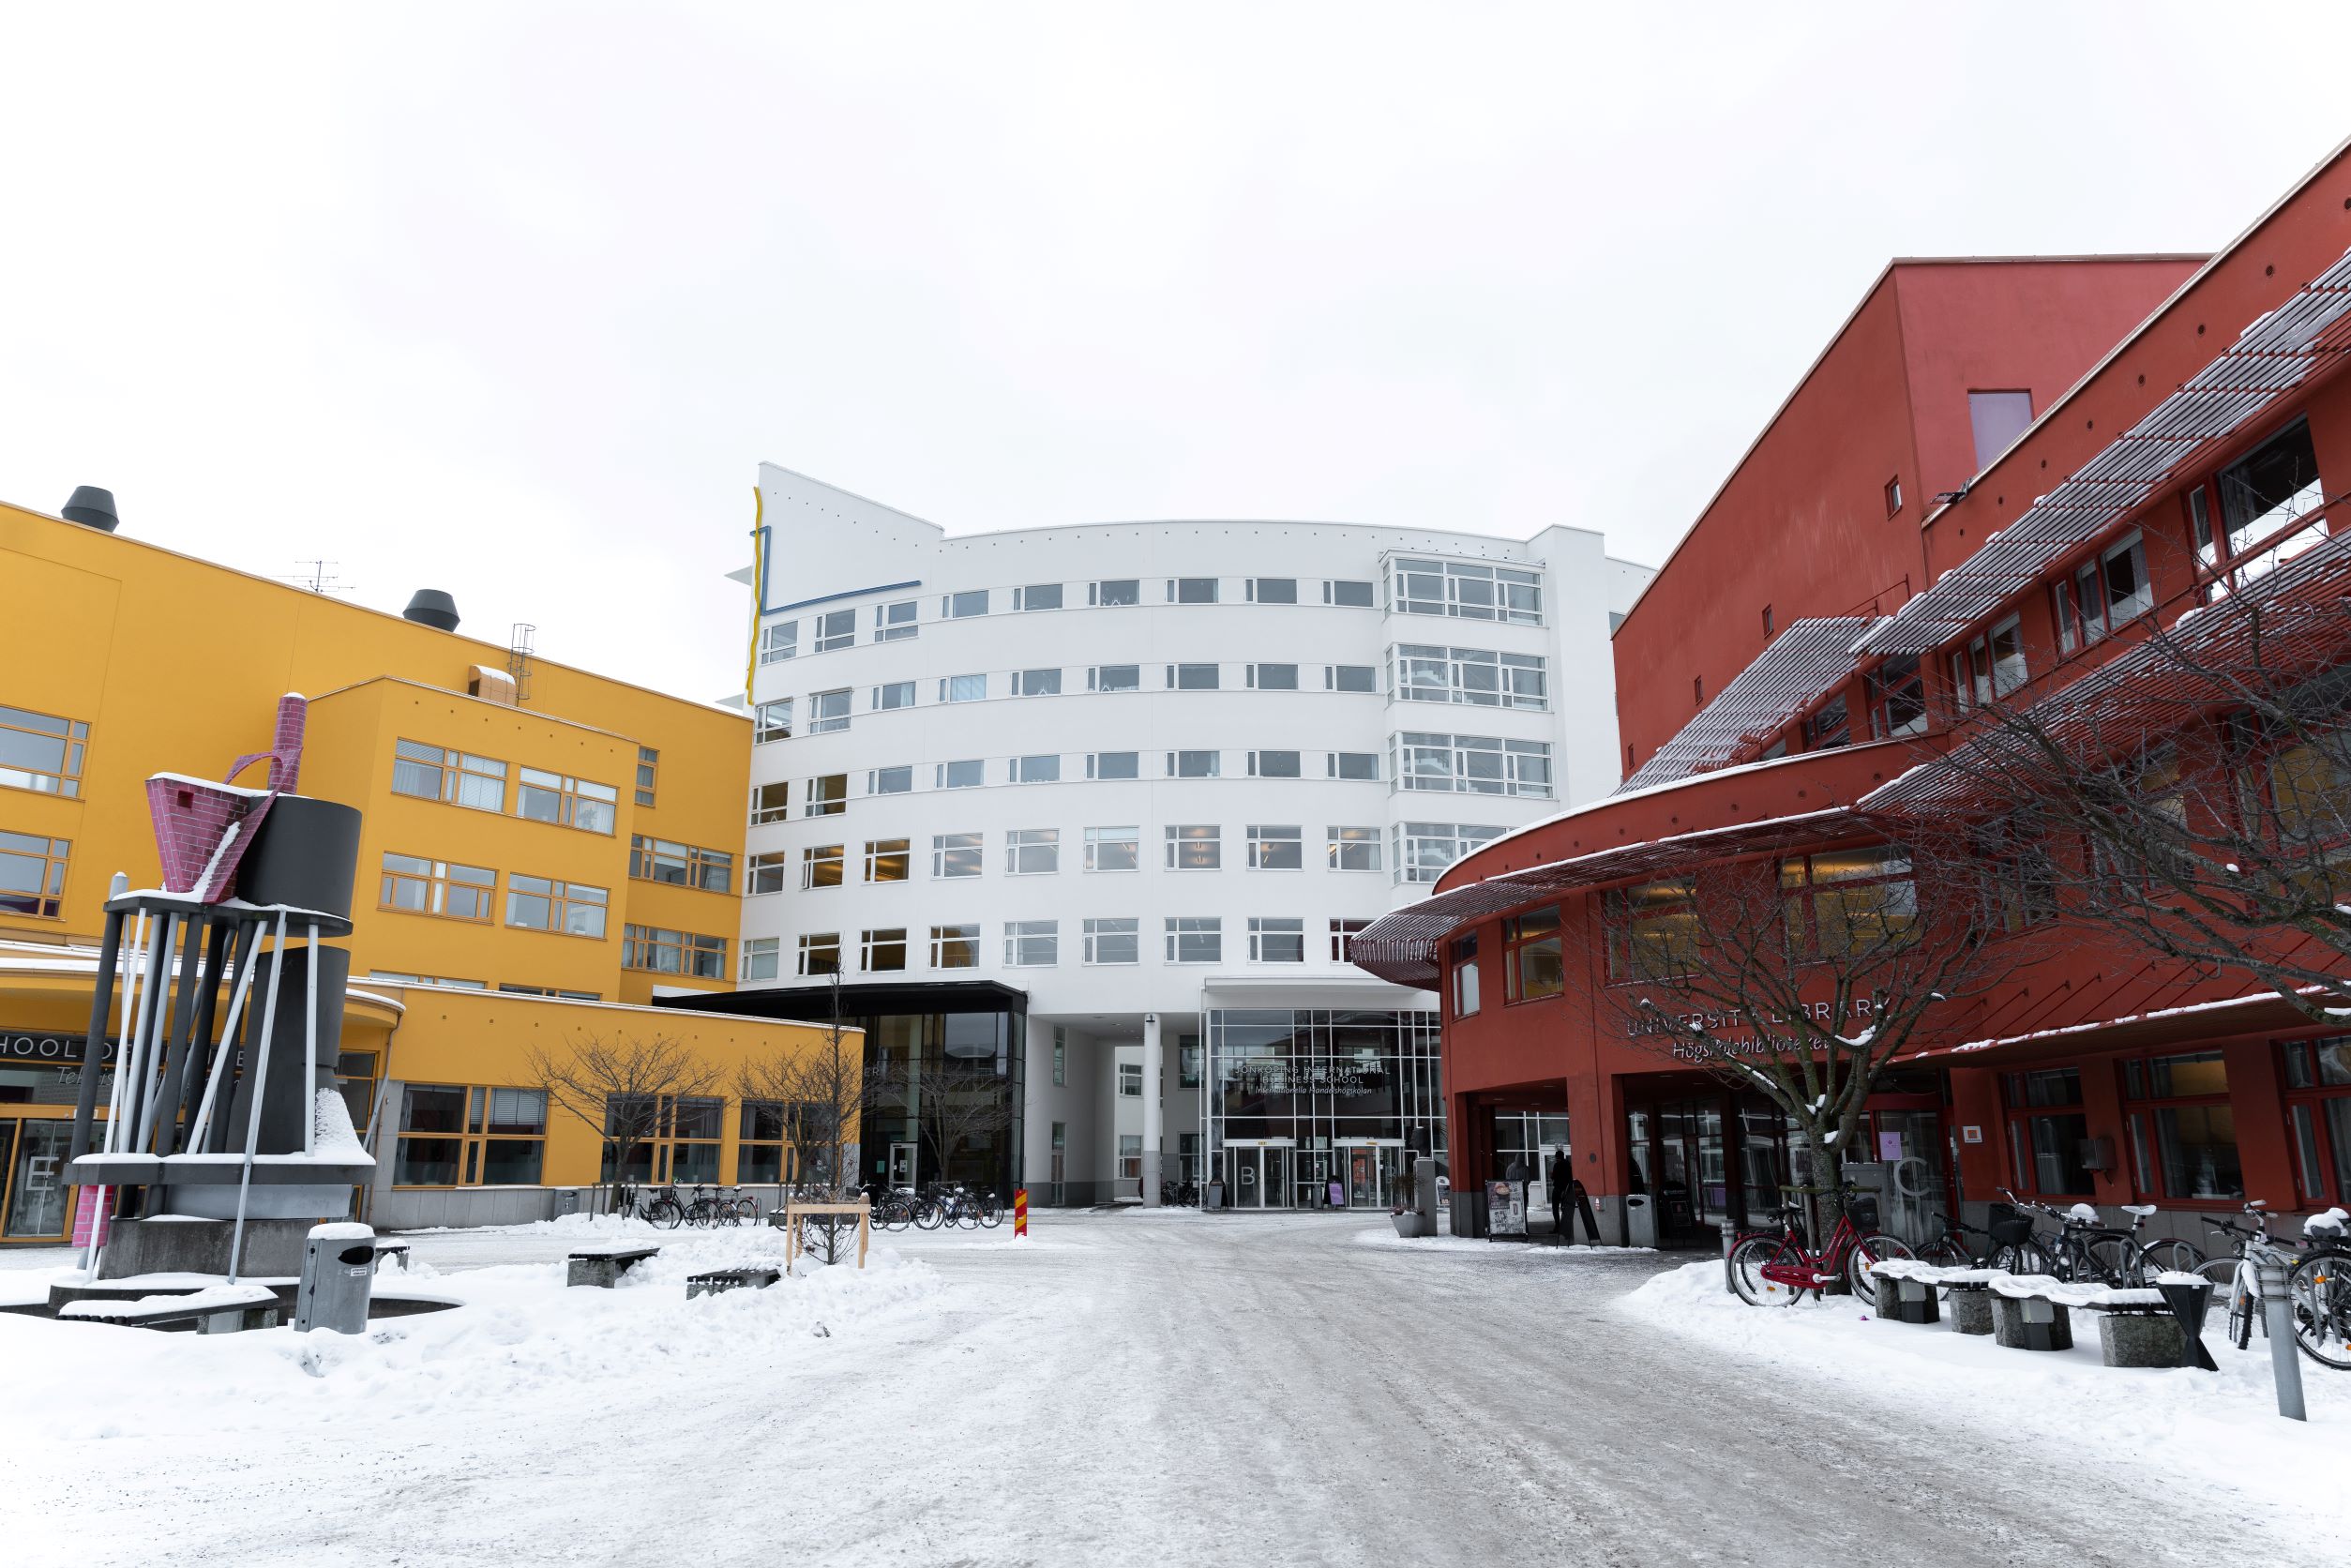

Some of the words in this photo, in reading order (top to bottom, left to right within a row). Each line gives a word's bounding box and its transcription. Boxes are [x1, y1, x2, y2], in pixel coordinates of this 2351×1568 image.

[1627, 1008, 1757, 1035] UNIVERSIT
[1771, 998, 1890, 1023] LBRR
[1234, 1064, 1299, 1075] JÖNKÖPING
[1304, 1065, 1392, 1076] INTERNATONAL
[1319, 1076, 1364, 1085] SCHOOL
[1307, 1086, 1373, 1096] Handelshögskolan
[25, 1156, 60, 1191] E
[1241, 1166, 1256, 1185] B
[1893, 1156, 1931, 1198] C
